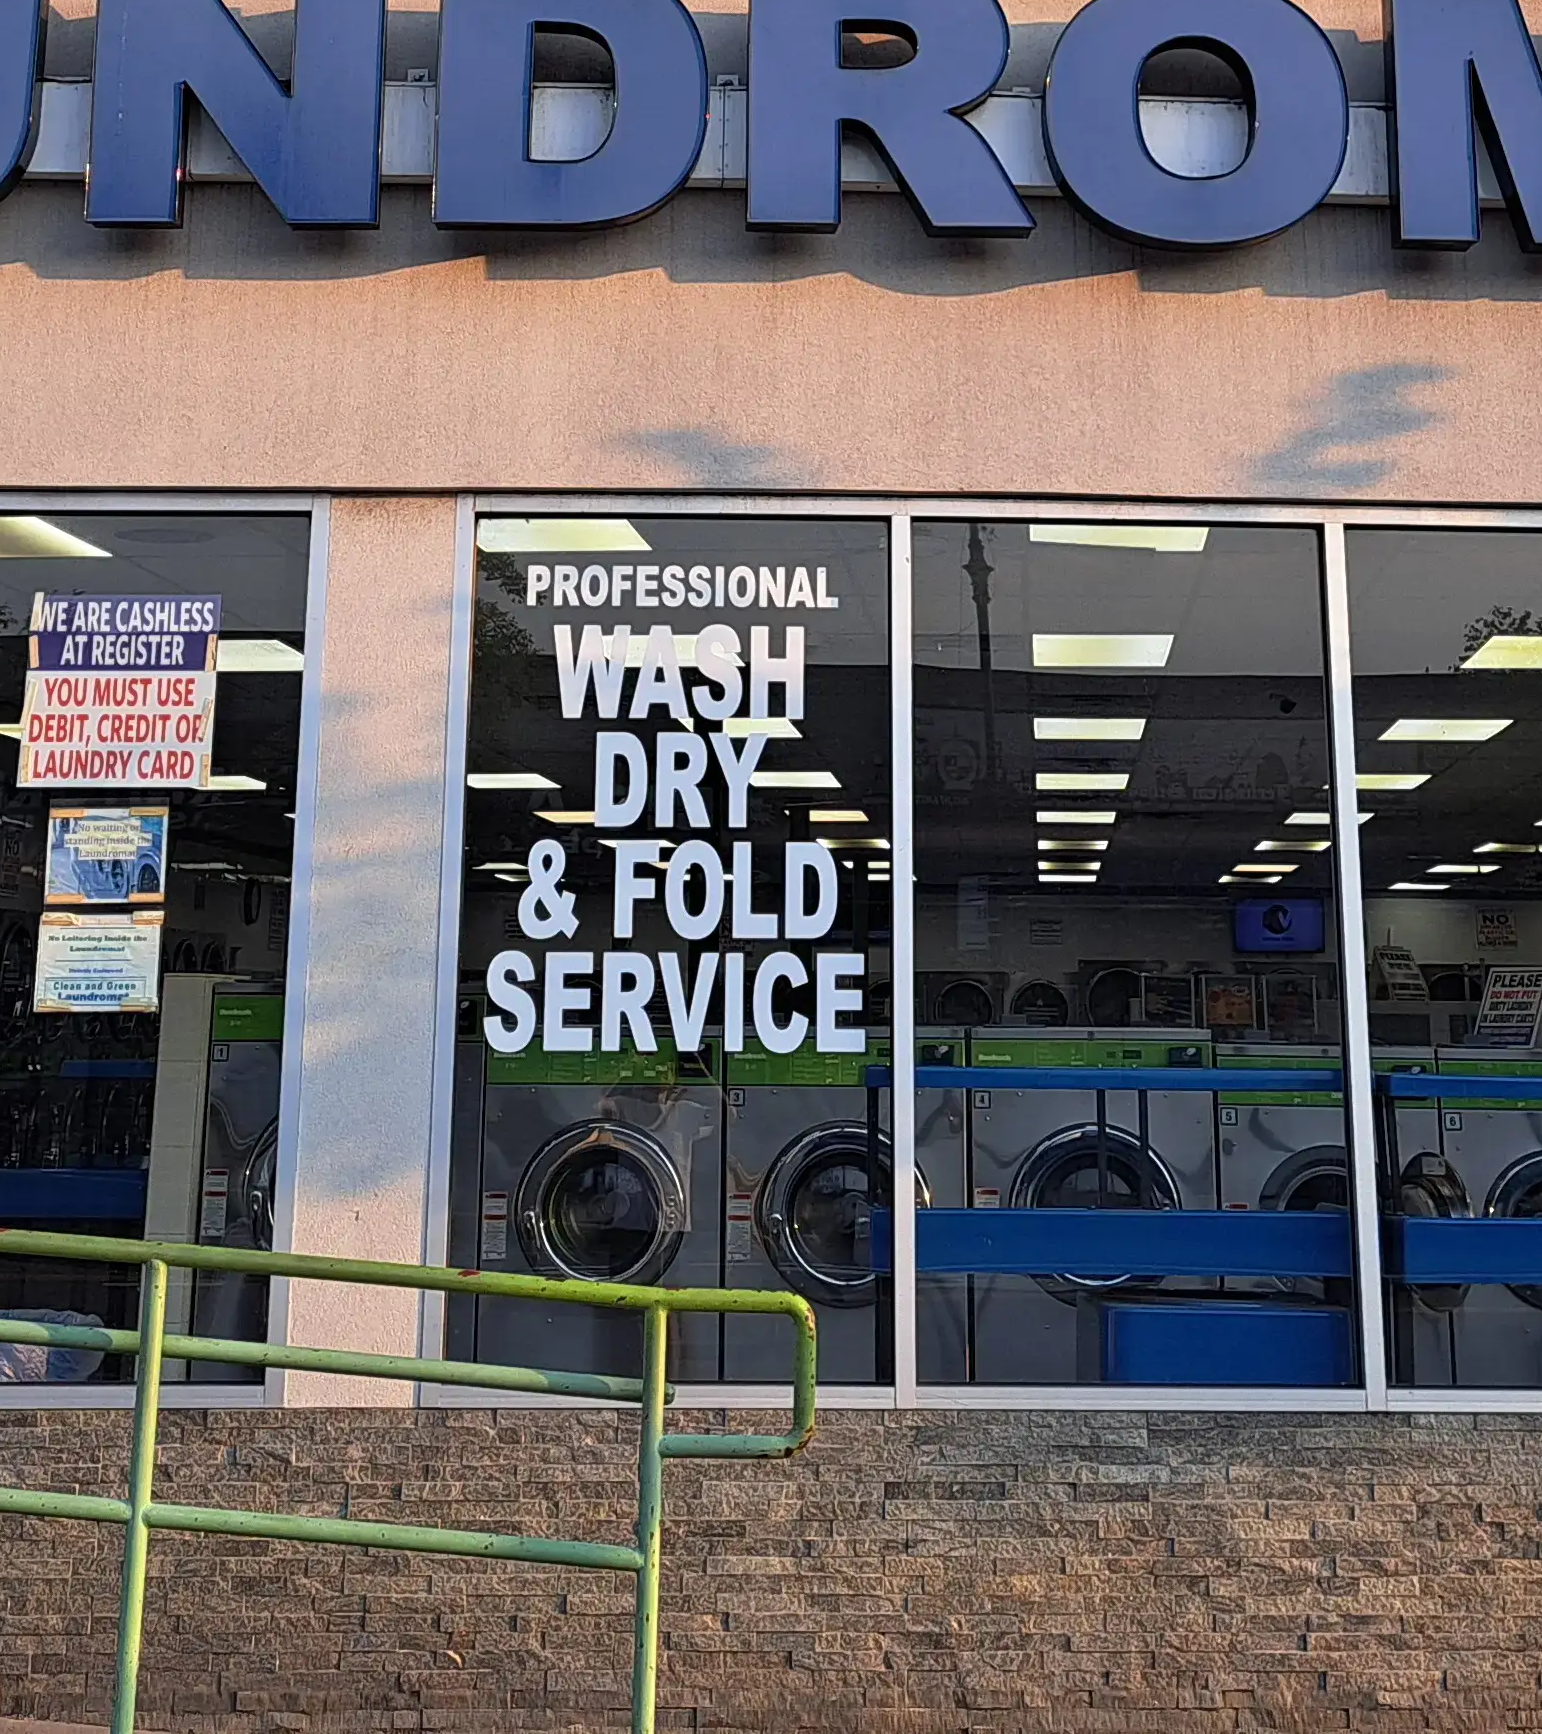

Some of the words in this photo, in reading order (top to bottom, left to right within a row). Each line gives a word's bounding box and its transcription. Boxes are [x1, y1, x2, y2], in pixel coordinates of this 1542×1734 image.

[525, 564, 839, 608] PROFESSIONAL
[40, 601, 67, 632] WE
[71, 601, 112, 632] ARE
[115, 601, 214, 632] CASHLESS
[60, 634, 88, 666] AT
[91, 634, 185, 666] REGISTER
[553, 623, 805, 720] WASH
[44, 677, 88, 707] YOU
[92, 677, 152, 707] MUST
[156, 677, 196, 707] USE
[28, 713, 91, 748] DEBIT,
[96, 713, 171, 744] CREDIT
[32, 750, 133, 780] LAUNDRY
[137, 750, 195, 780] CARD
[594, 731, 769, 828] DRY
[93, 823, 128, 834] waiting
[106, 835, 135, 845] inside
[517, 838, 580, 940] &
[613, 840, 839, 940] FOLD
[1482, 914, 1509, 925] NO
[53, 981, 82, 991] Clean
[84, 981, 103, 991] and
[106, 981, 137, 991] Green
[482, 950, 867, 1054] SERVICE
